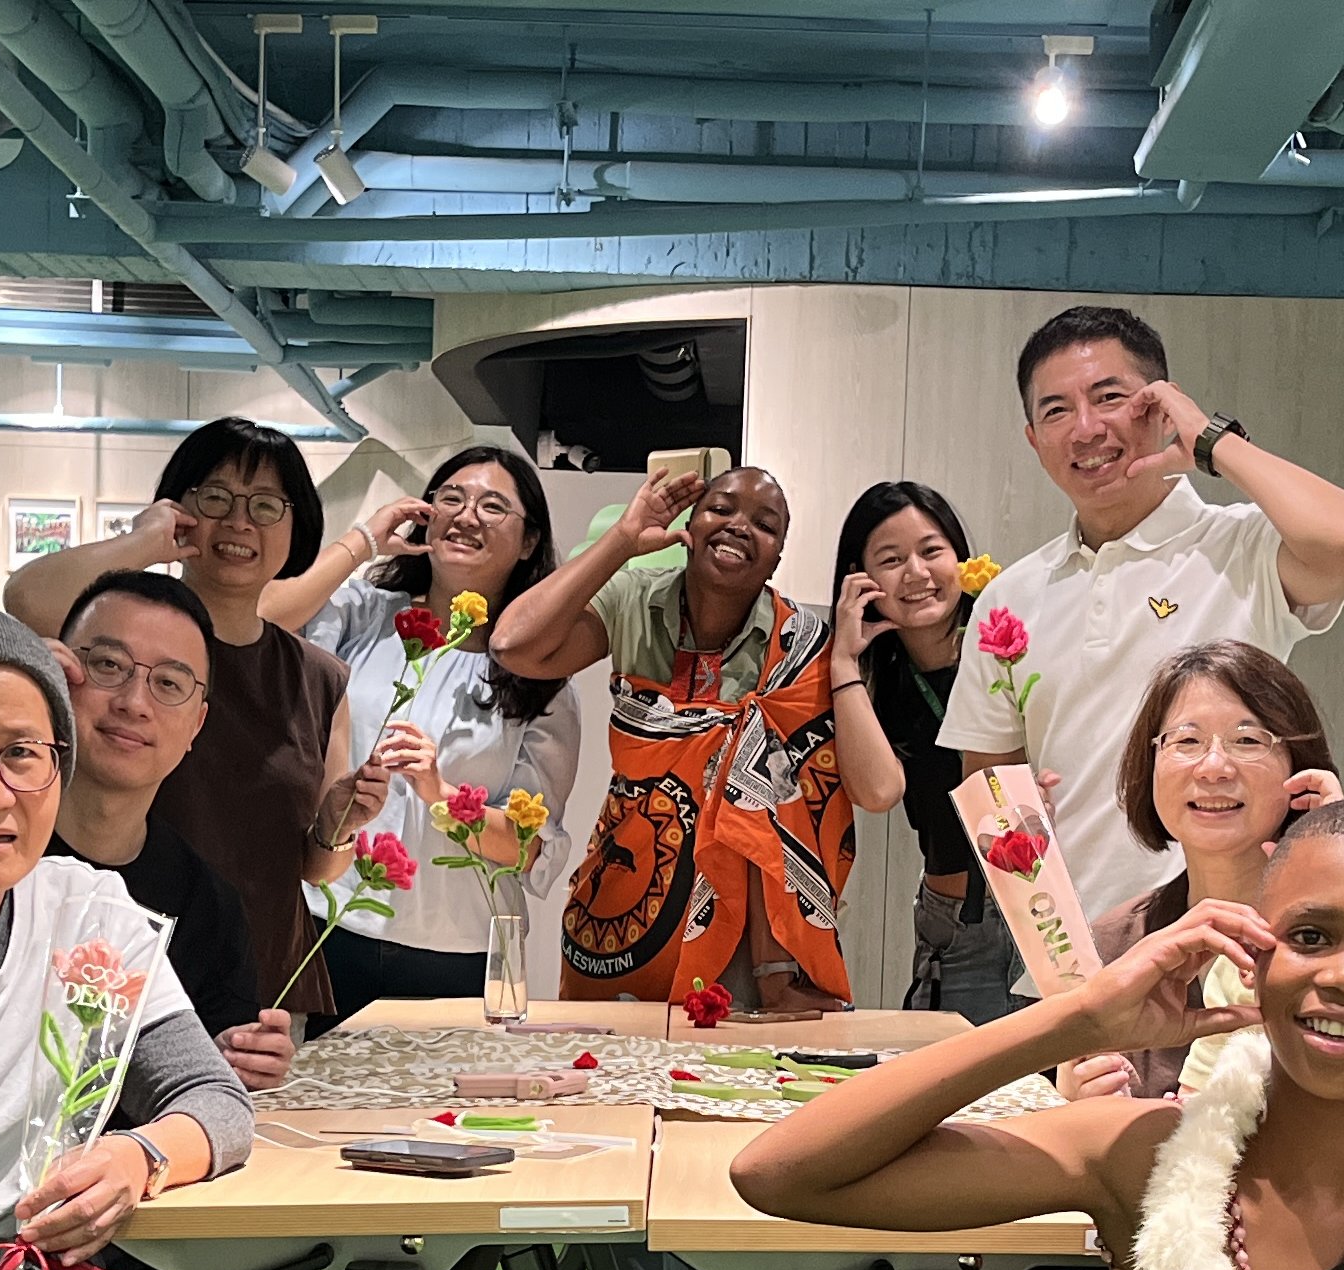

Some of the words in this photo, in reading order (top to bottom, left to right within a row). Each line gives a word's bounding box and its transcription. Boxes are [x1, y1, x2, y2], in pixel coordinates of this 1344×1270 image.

[1028, 891, 1087, 984] ONLY
[572, 950, 634, 975] ESWATINI
[64, 981, 130, 1020] DEAR
